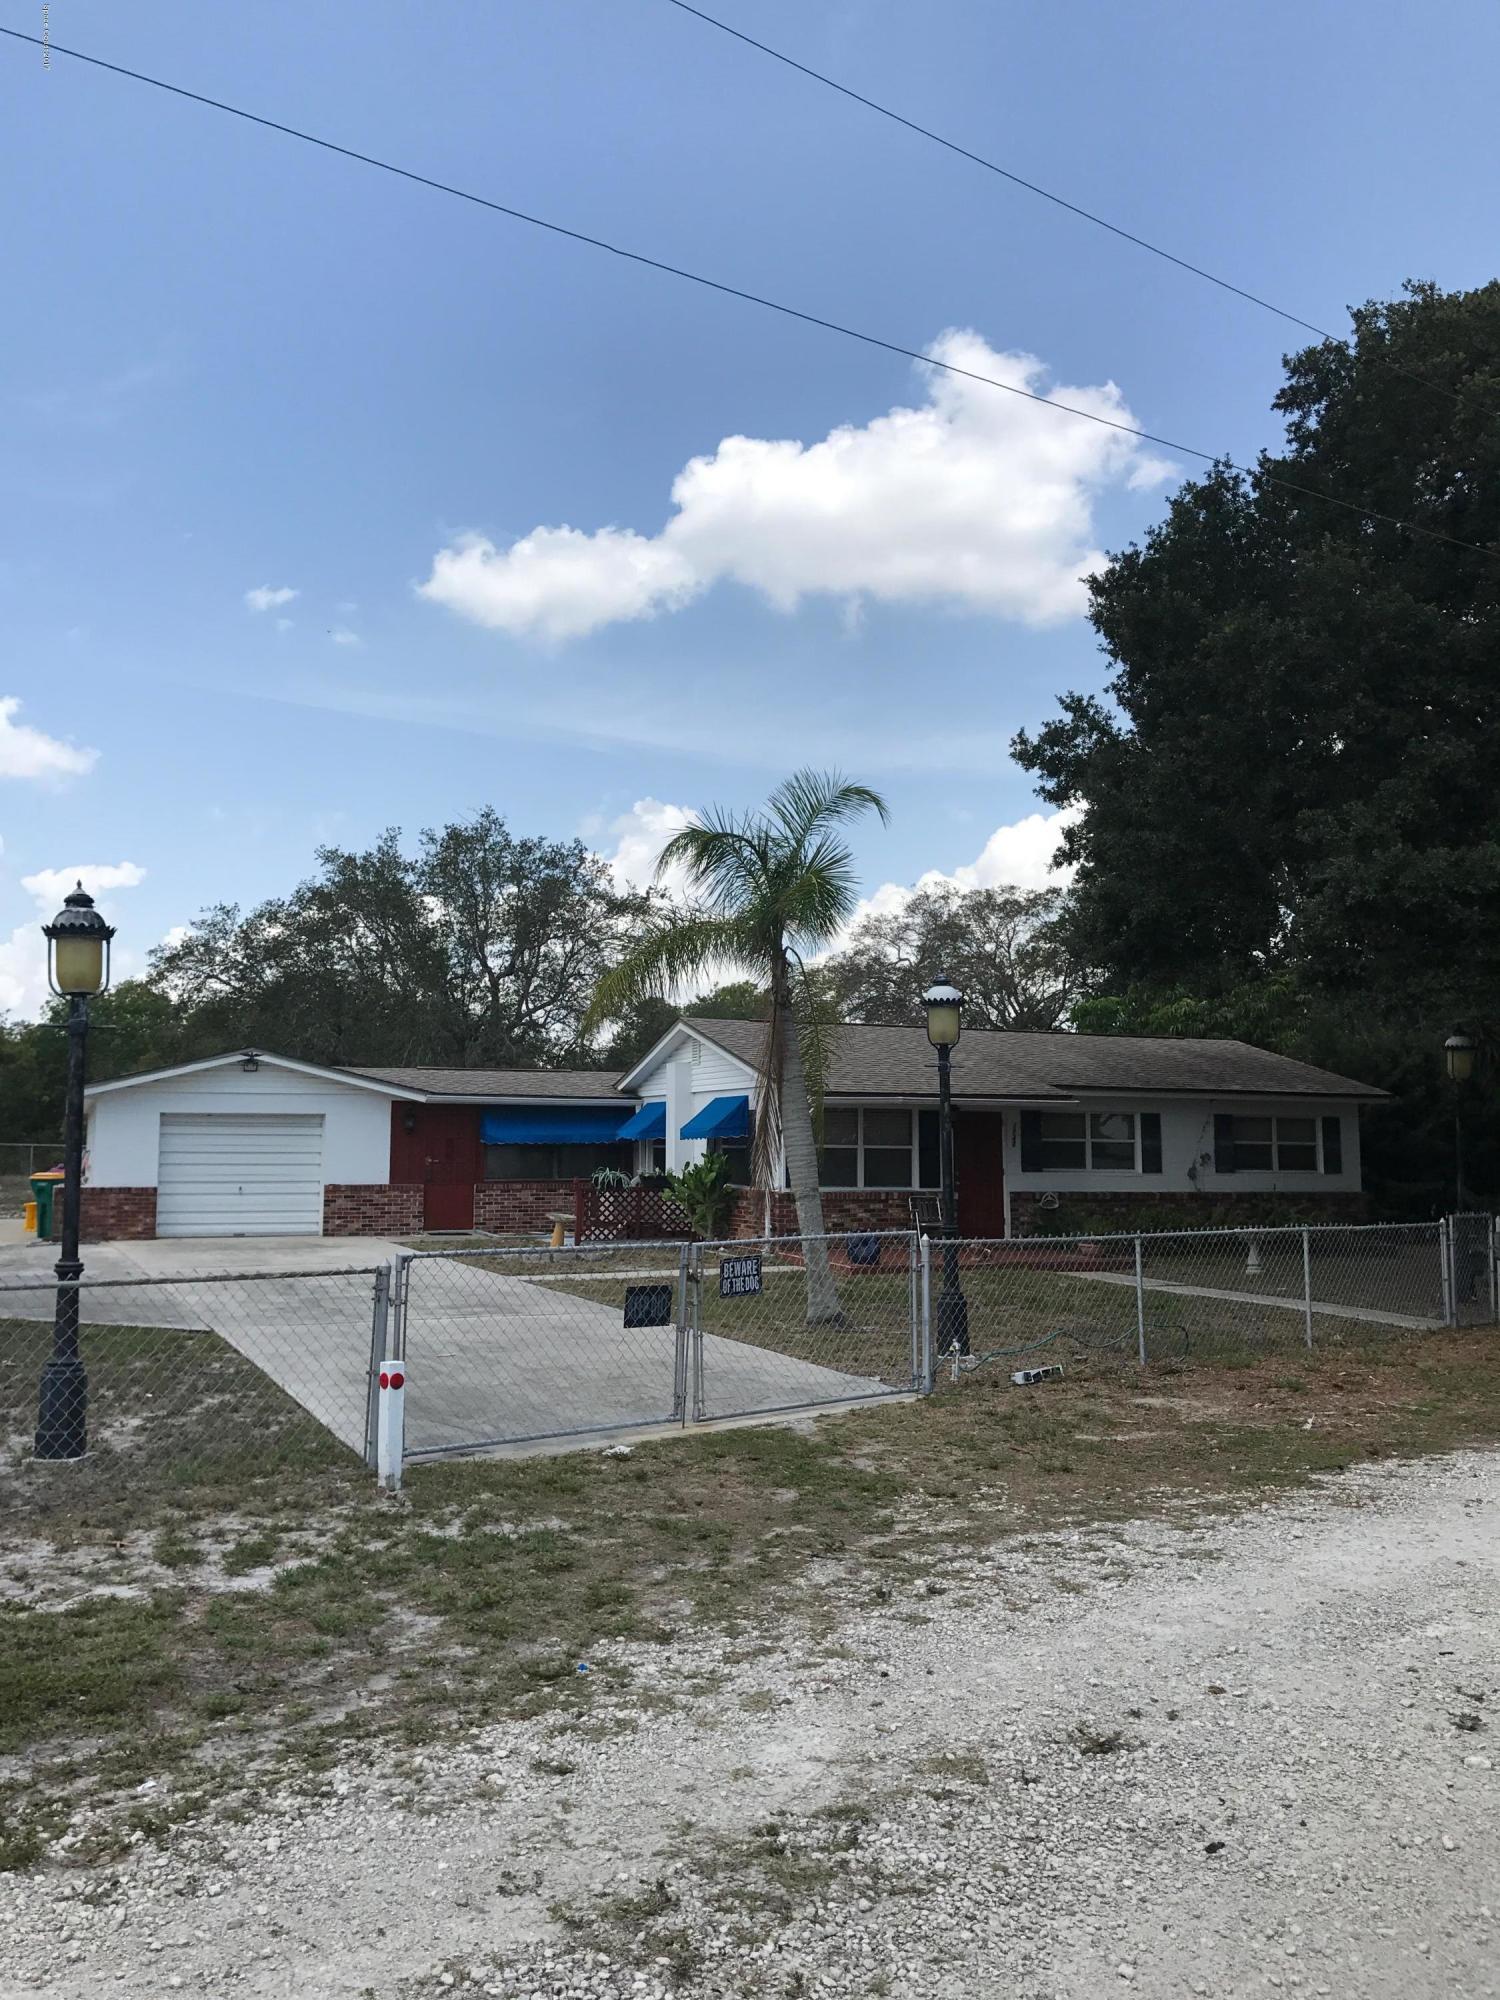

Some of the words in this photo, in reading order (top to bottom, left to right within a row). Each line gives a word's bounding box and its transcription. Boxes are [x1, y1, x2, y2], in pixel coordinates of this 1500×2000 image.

[723, 1260, 758, 1278] BEWARE
[722, 1279, 731, 1294] OF
[732, 1277, 745, 1292] THE
[745, 1275, 760, 1290] DOG
